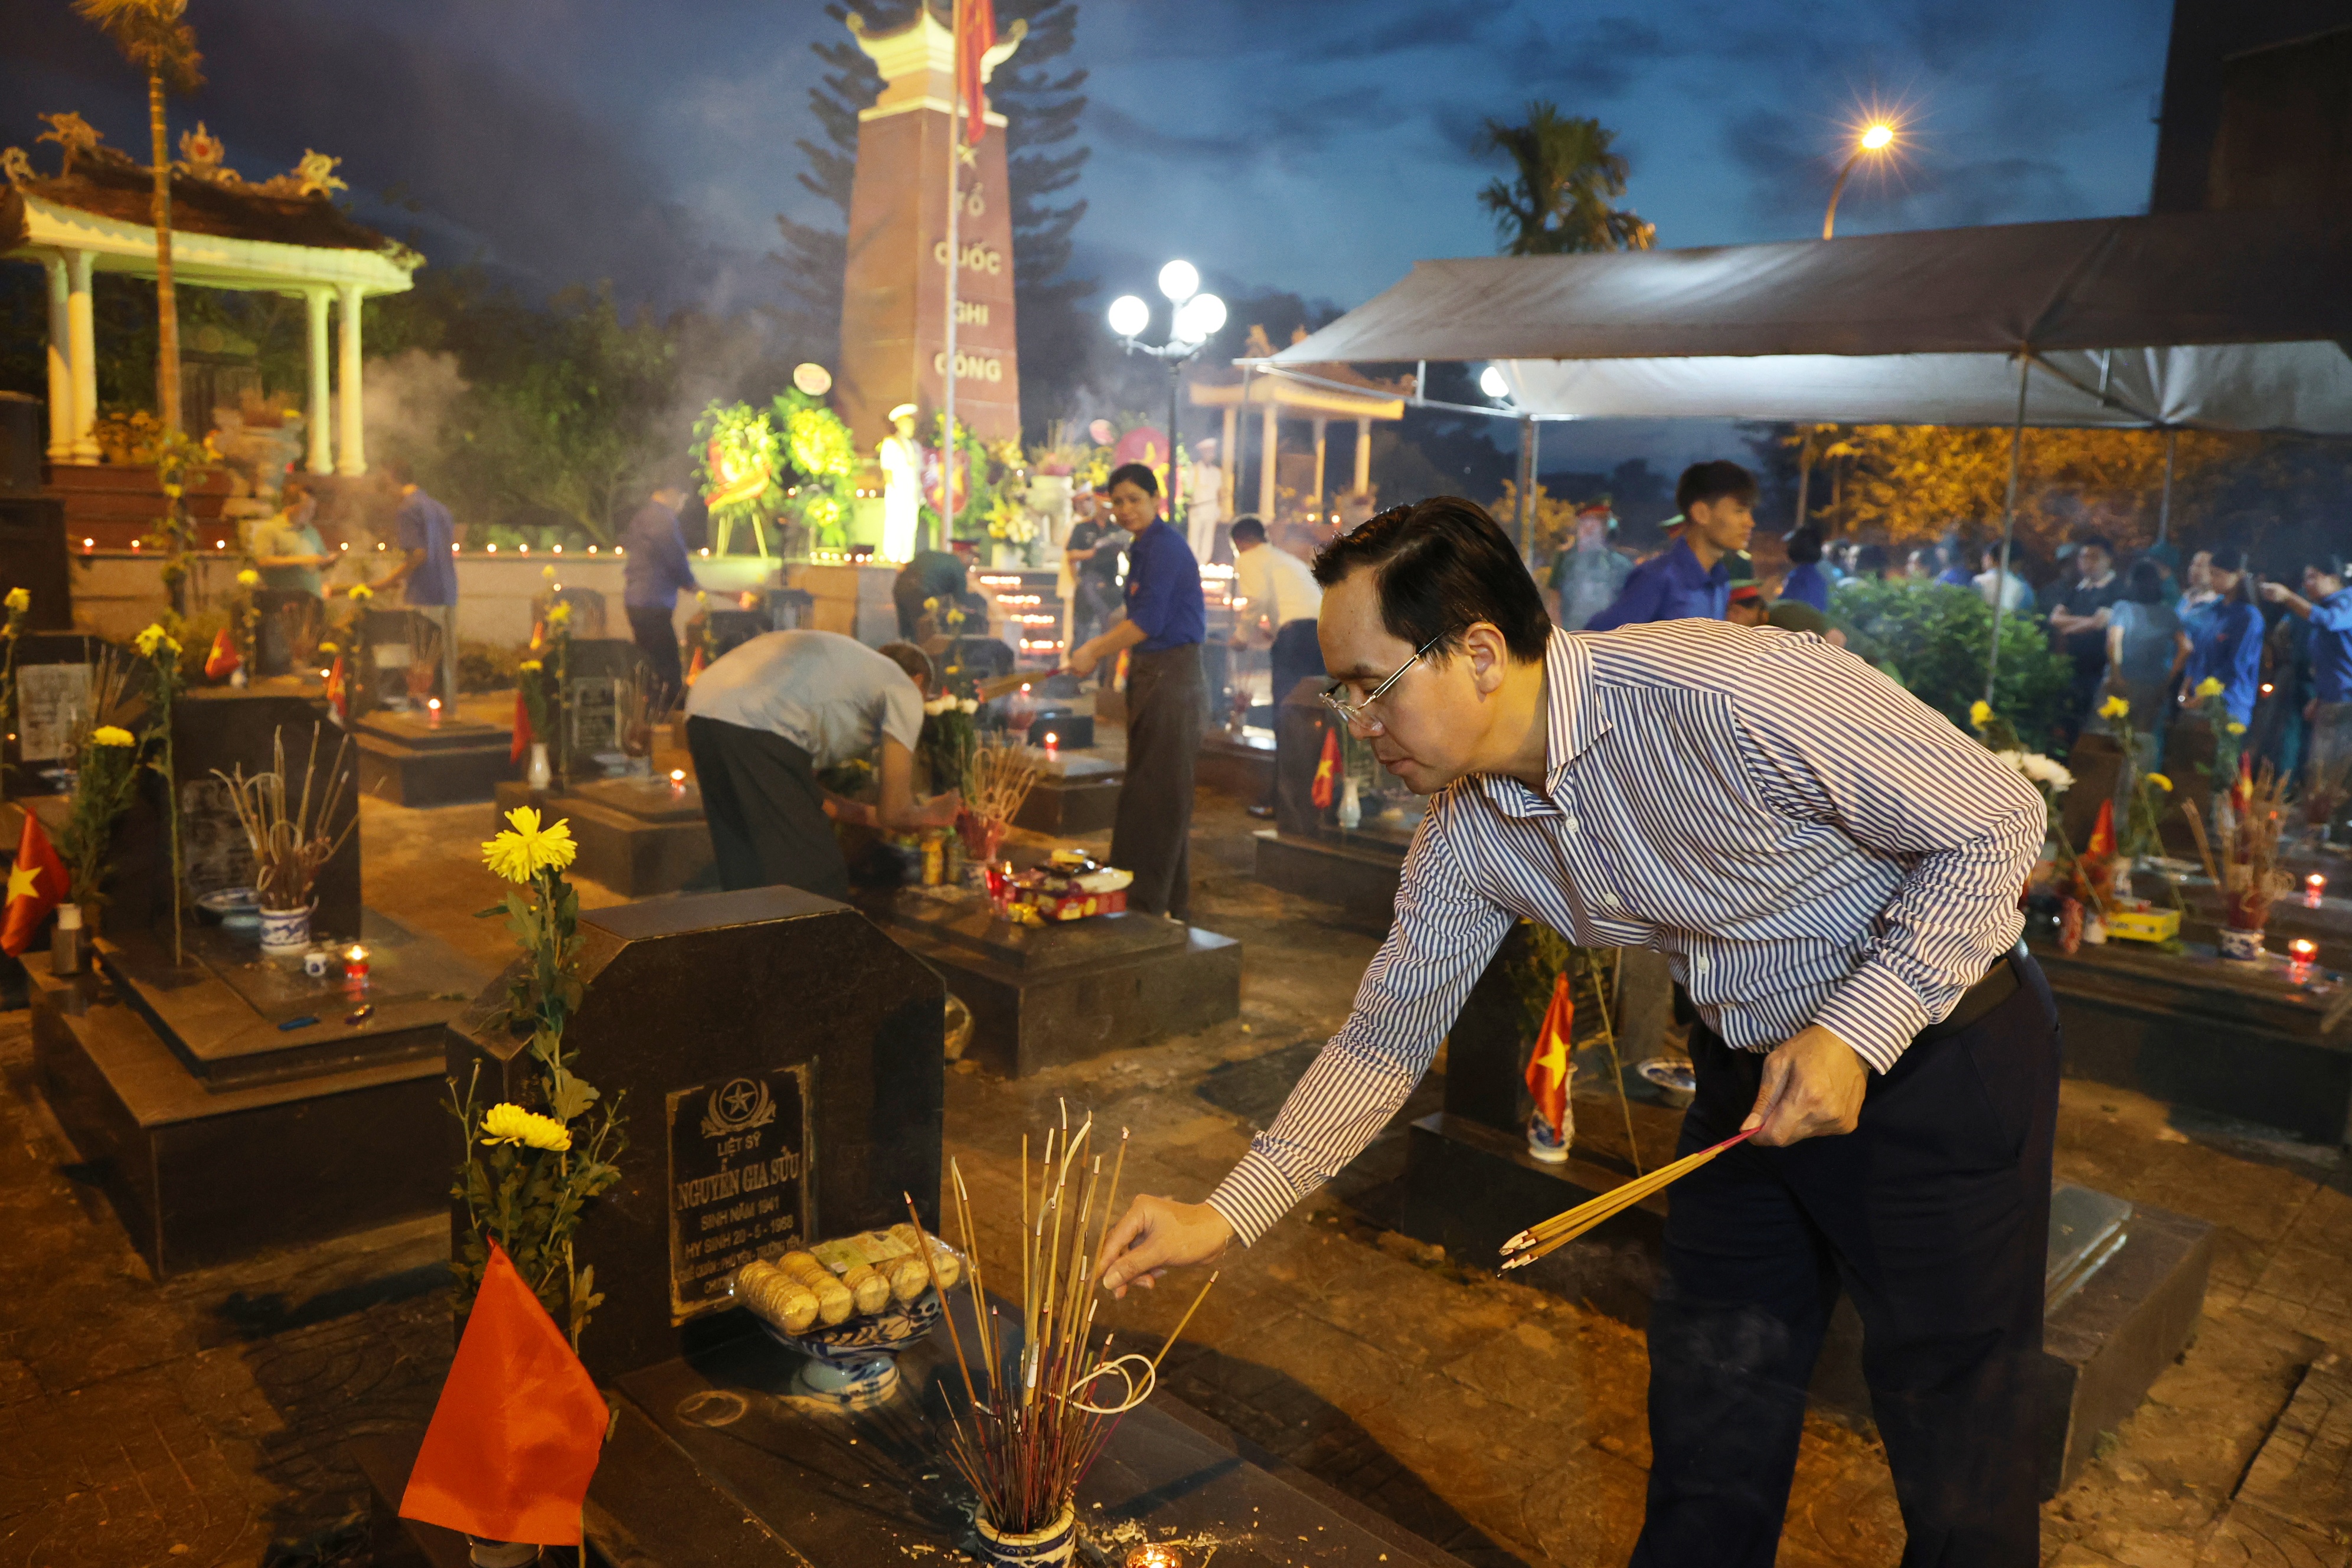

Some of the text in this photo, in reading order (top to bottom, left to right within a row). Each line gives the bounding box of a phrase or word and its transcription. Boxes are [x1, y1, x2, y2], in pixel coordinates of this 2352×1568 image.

[934, 349, 1002, 383] CÔNG
[717, 1135, 741, 1157] LIỆT
[676, 1157, 740, 1210] NGUYỄN
[742, 1161, 770, 1192] GIA
[701, 1210, 728, 1231] SINH
[730, 1201, 756, 1223] NĂM
[685, 1240, 703, 1260] HY
[704, 1232, 731, 1253] SINH
